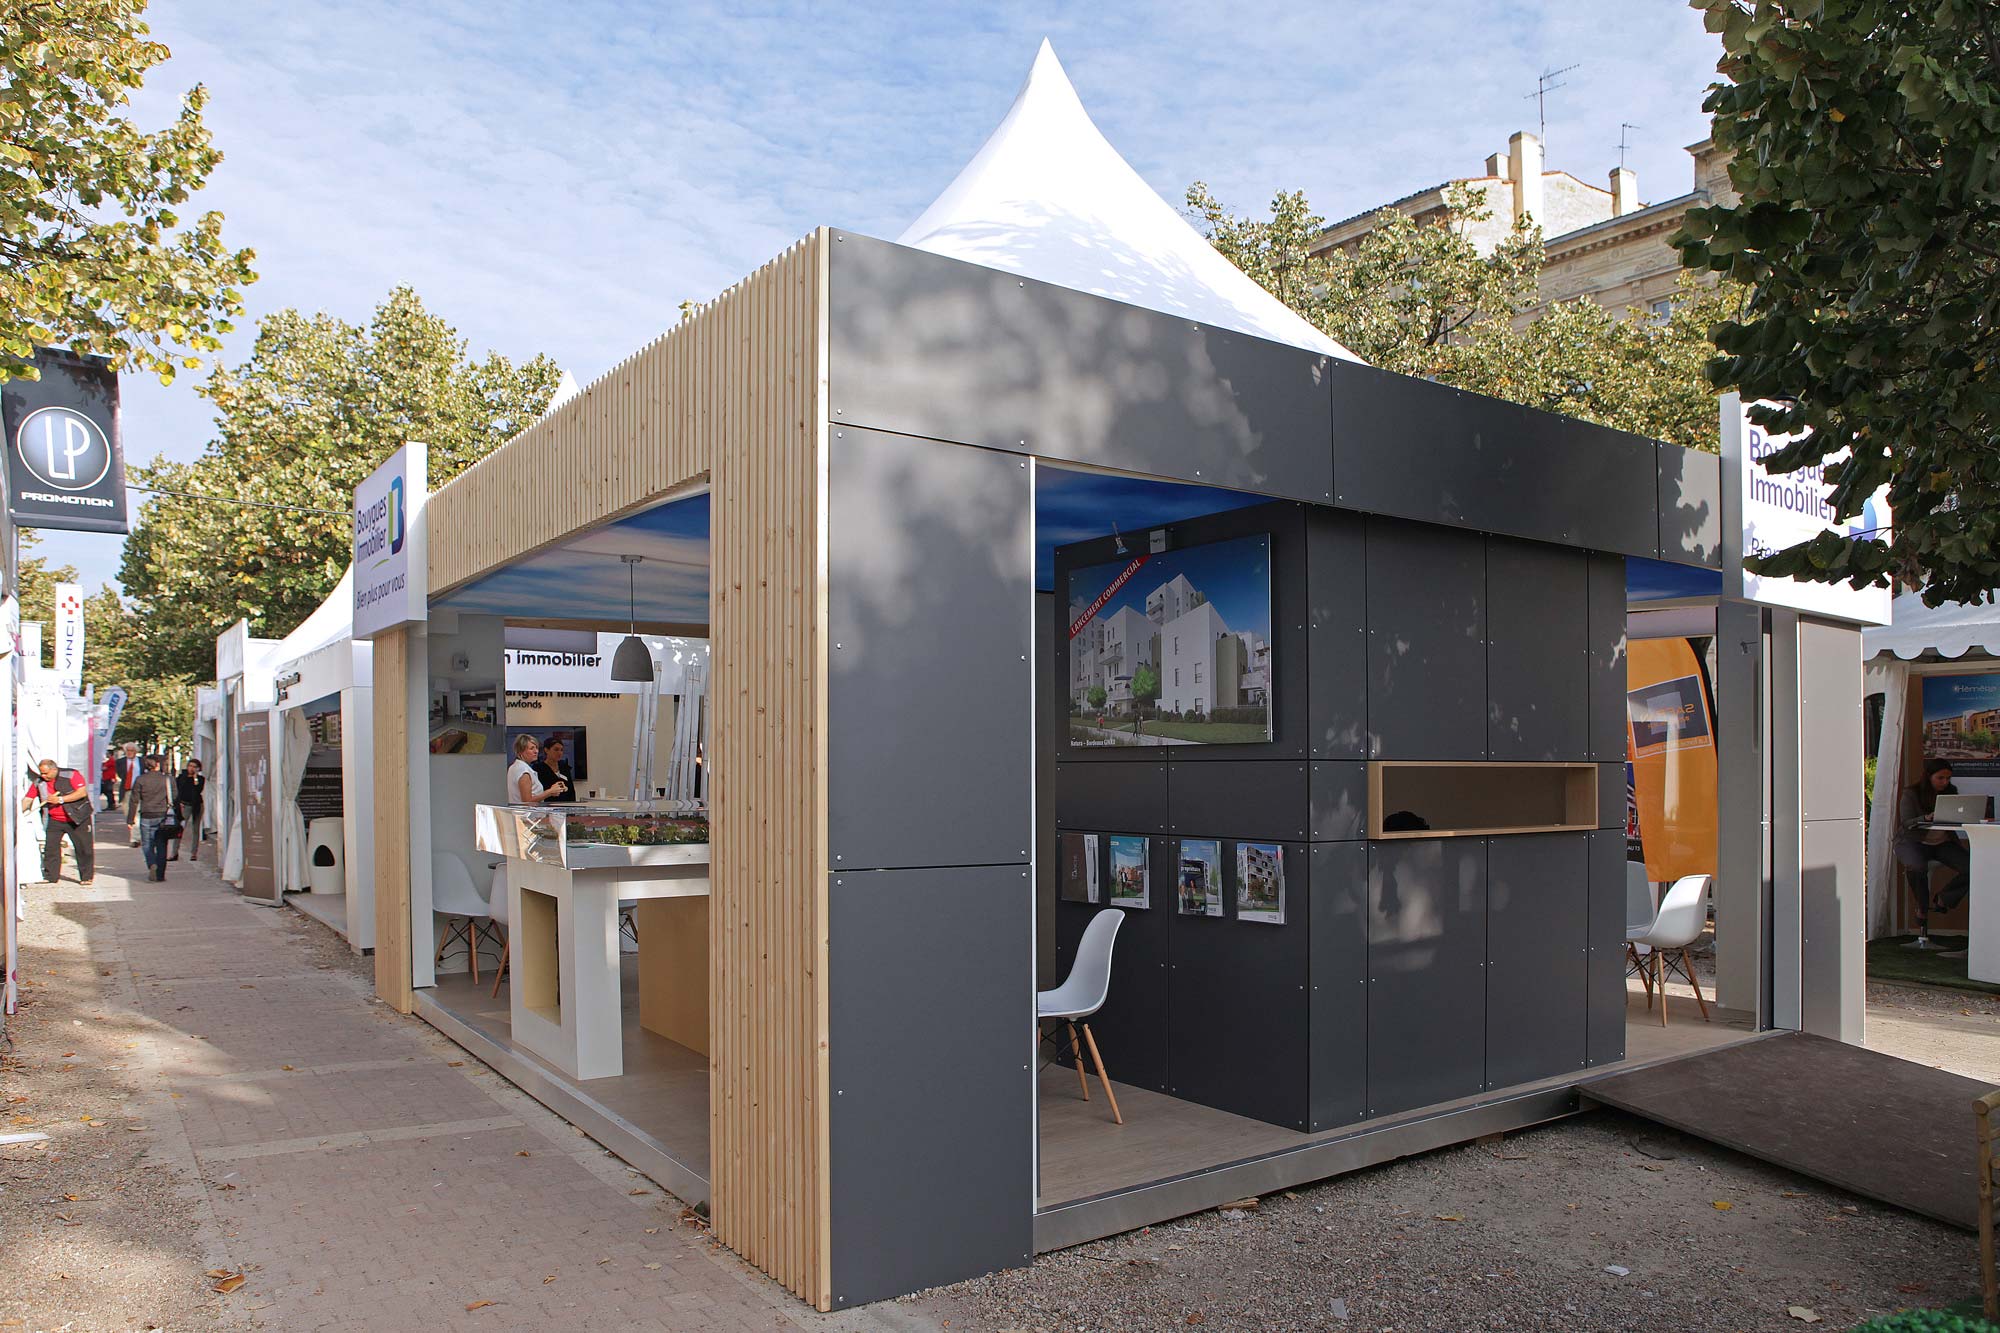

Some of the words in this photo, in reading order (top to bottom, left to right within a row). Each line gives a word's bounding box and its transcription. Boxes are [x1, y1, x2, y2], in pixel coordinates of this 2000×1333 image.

[21, 492, 114, 507] PROMOTION
[357, 496, 387, 535] Bouygues
[357, 527, 387, 564] Immobilier
[357, 591, 367, 610] Bien
[367, 583, 377, 607] plus
[378, 578, 391, 604] pour
[391, 573, 405, 592] vous
[1071, 598, 1104, 634] LANCEMENT
[1102, 560, 1141, 600] COMMERCIAL
[65, 620, 74, 669] VINCI
[517, 651, 602, 667] immobilier
